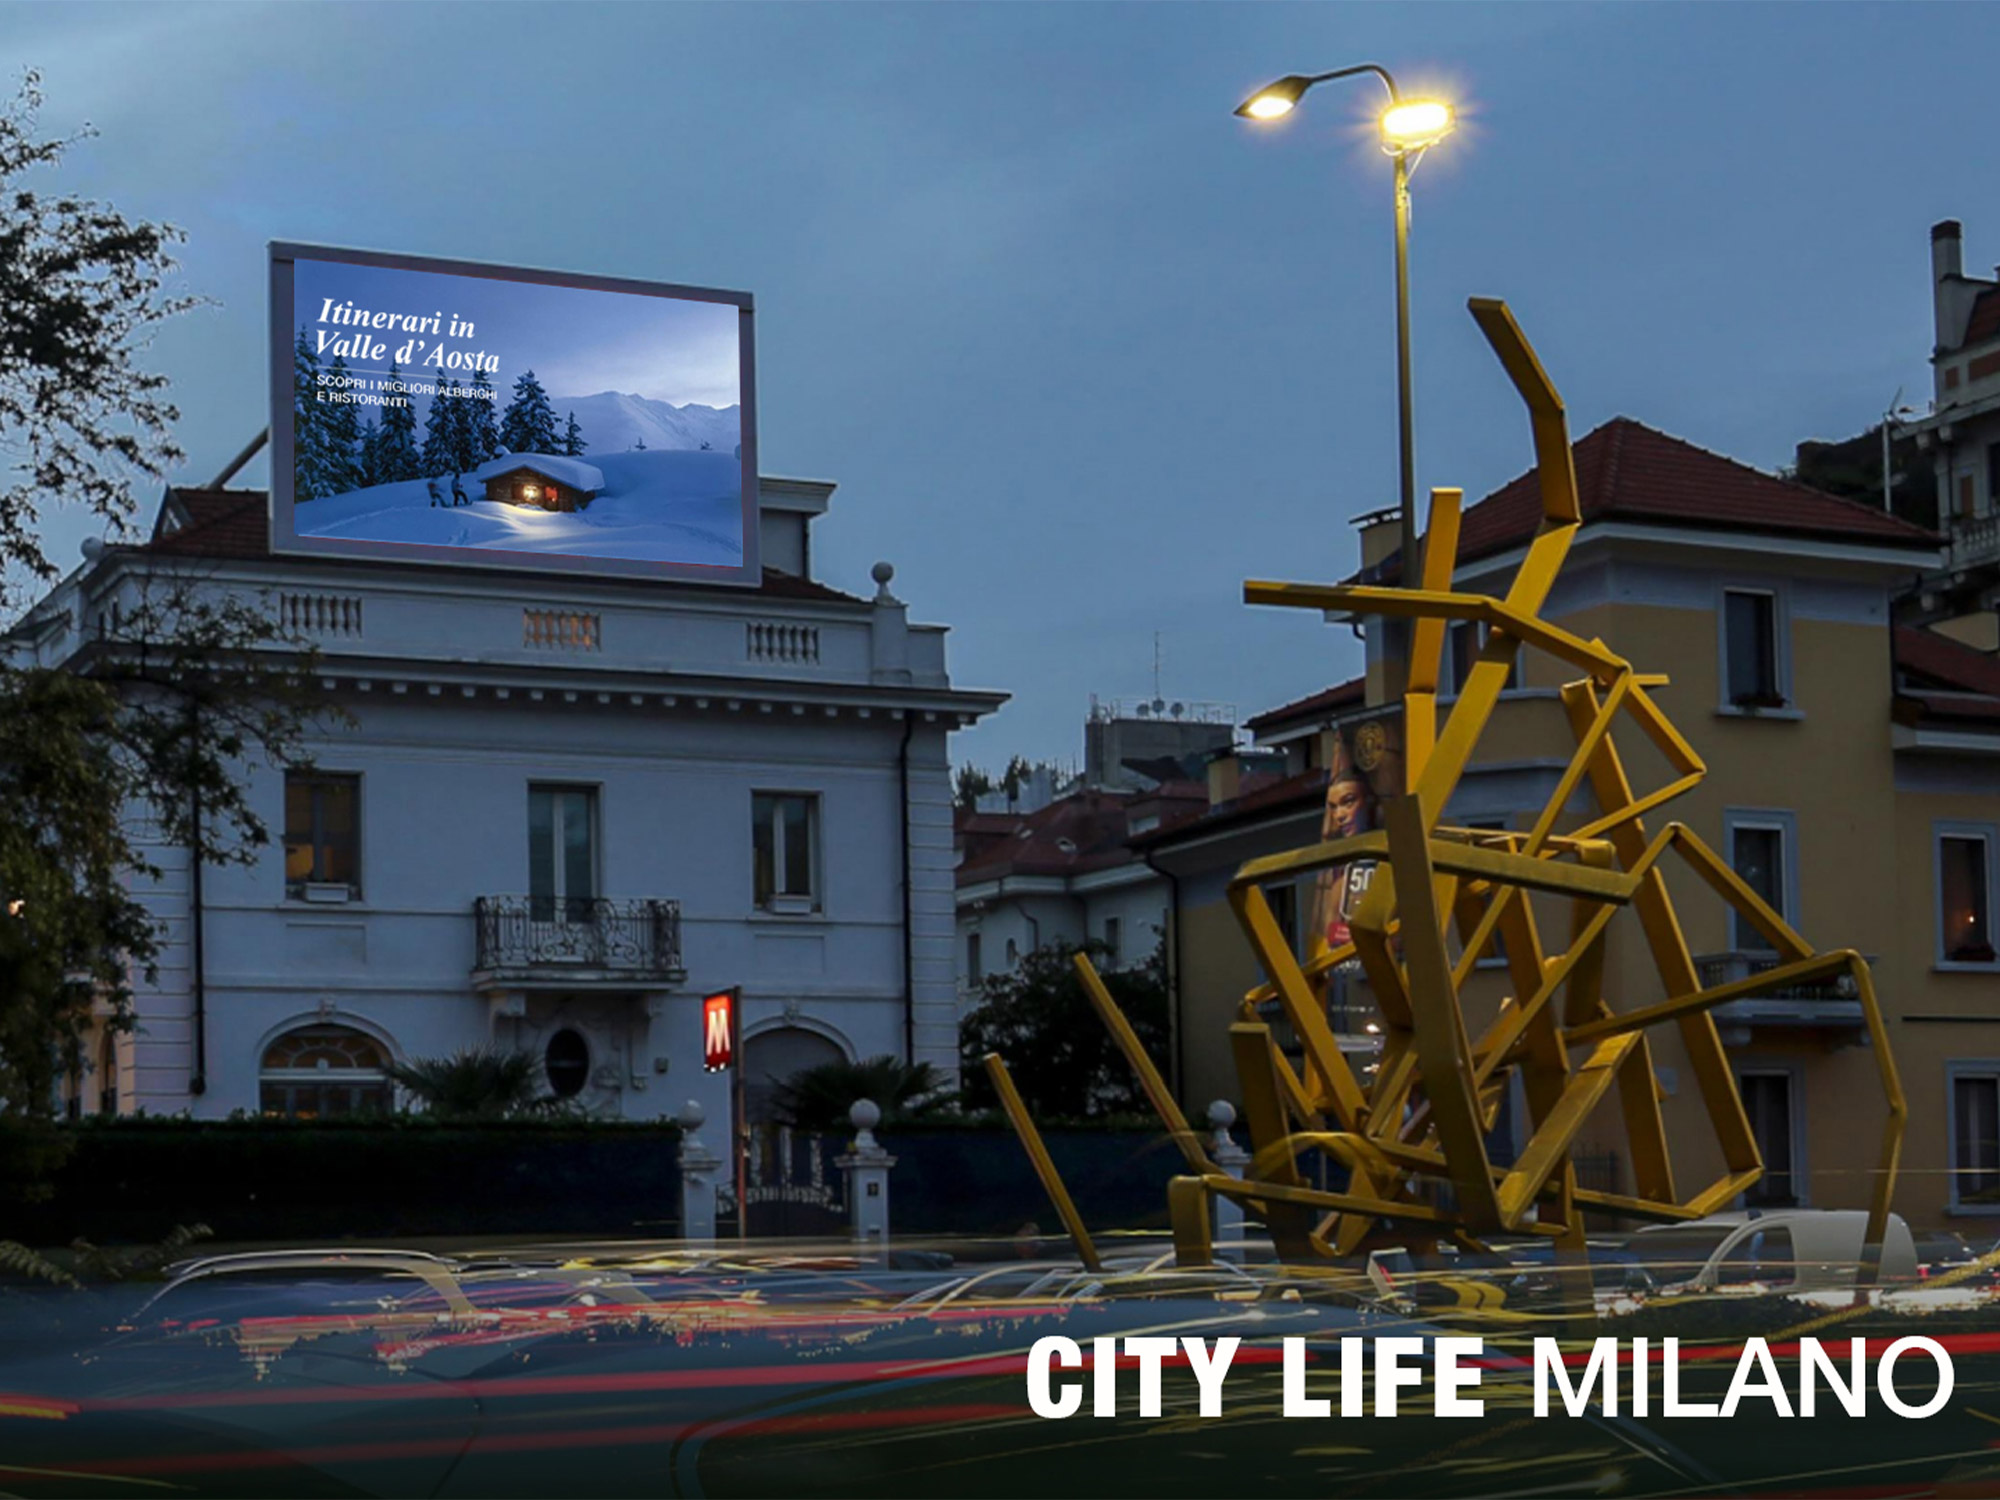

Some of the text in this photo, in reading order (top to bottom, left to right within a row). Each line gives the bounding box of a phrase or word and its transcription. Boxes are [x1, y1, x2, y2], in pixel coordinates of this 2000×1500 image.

[316, 297, 475, 339] Itinerari in
[316, 329, 387, 361] Valle
[316, 374, 366, 390] SCOPRI
[377, 380, 435, 395] MIGLIORI
[438, 385, 498, 401] ALBERGHI
[316, 391, 408, 408] E RISTORANTI
[705, 1007, 731, 1057] M
